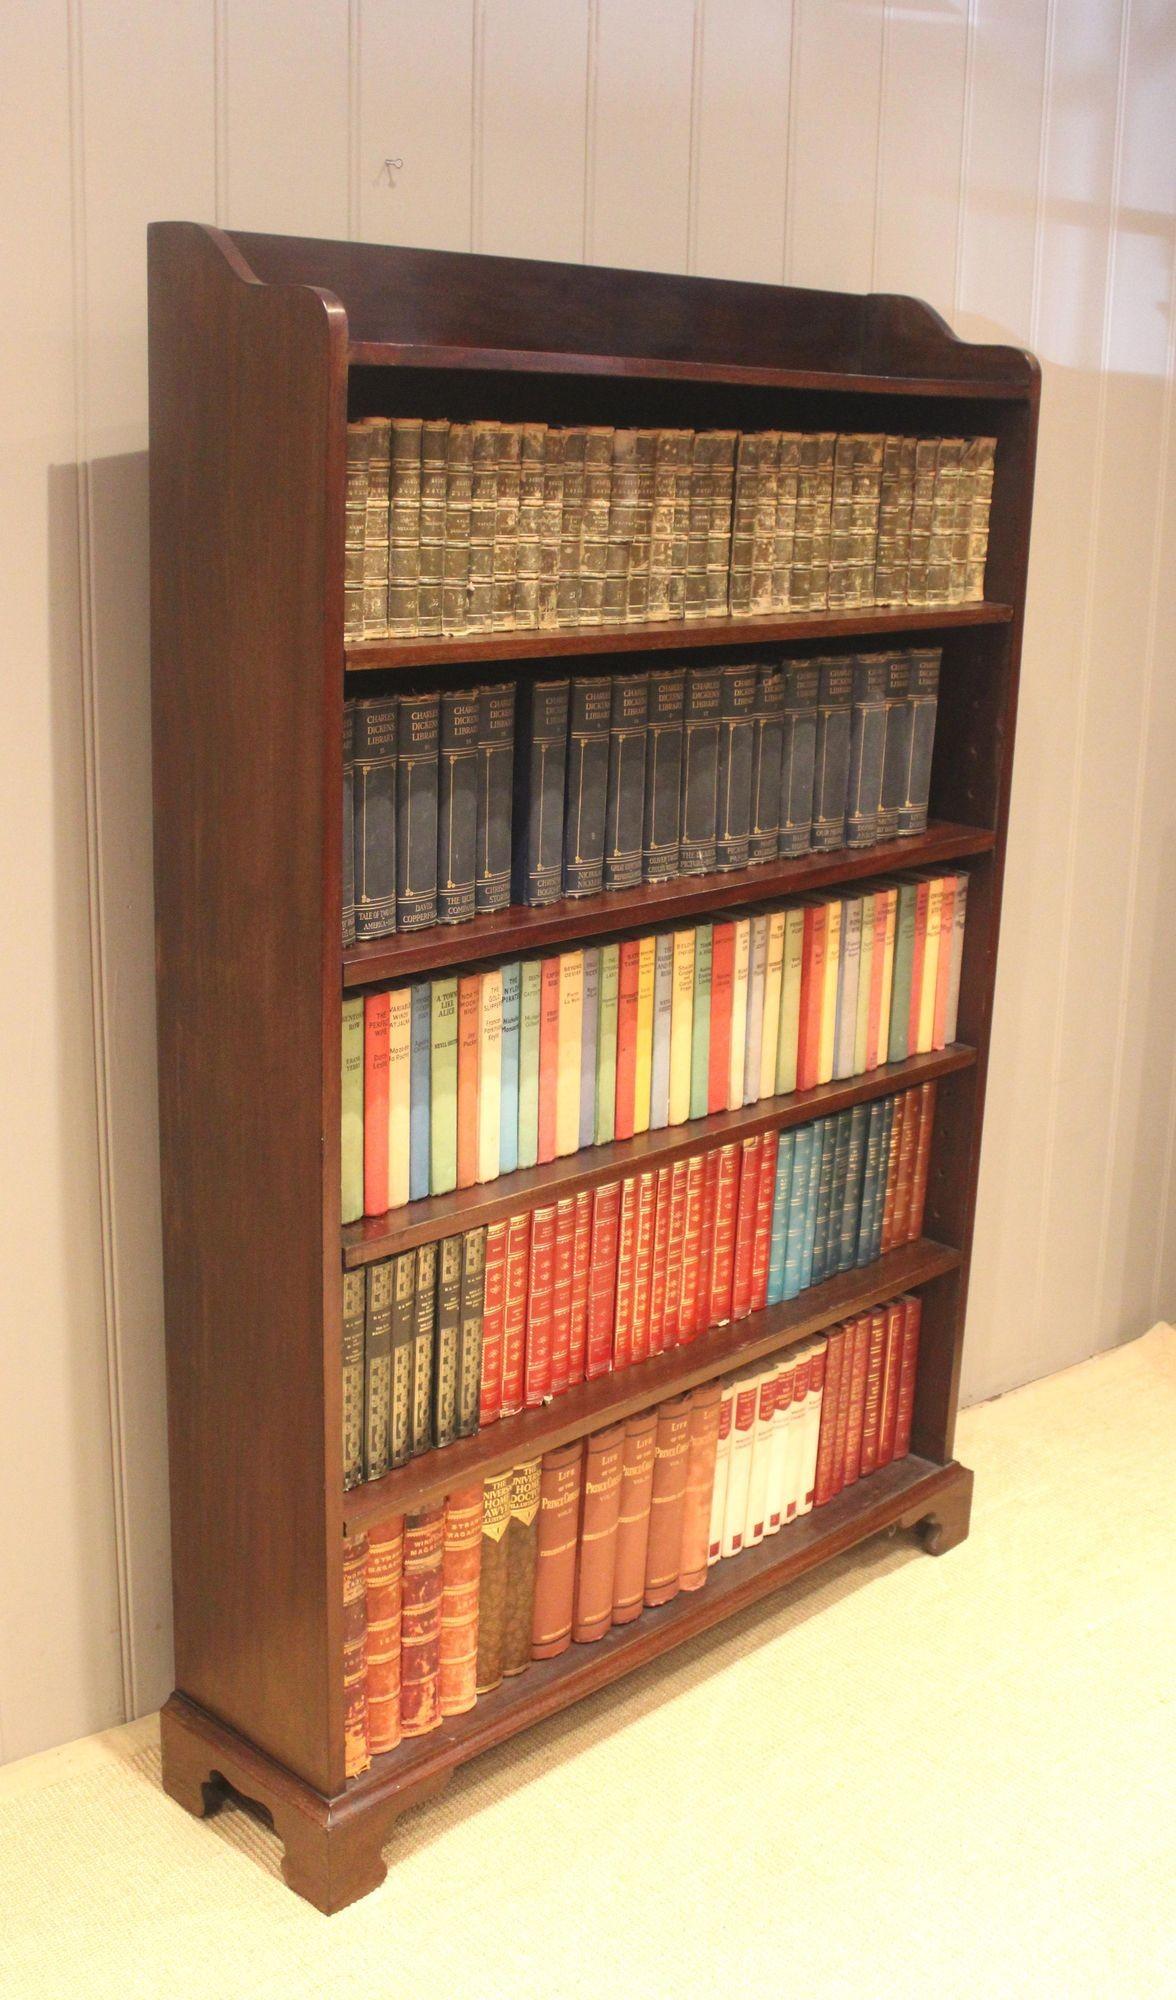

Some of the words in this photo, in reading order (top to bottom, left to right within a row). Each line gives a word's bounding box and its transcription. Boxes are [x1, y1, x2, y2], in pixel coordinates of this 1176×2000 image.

[447, 897, 461, 905] THE
[415, 903, 433, 912] DAVID
[441, 1000, 454, 1009] LIKE
[438, 1007, 455, 1017] ALICE
[493, 1480, 506, 1490] THE
